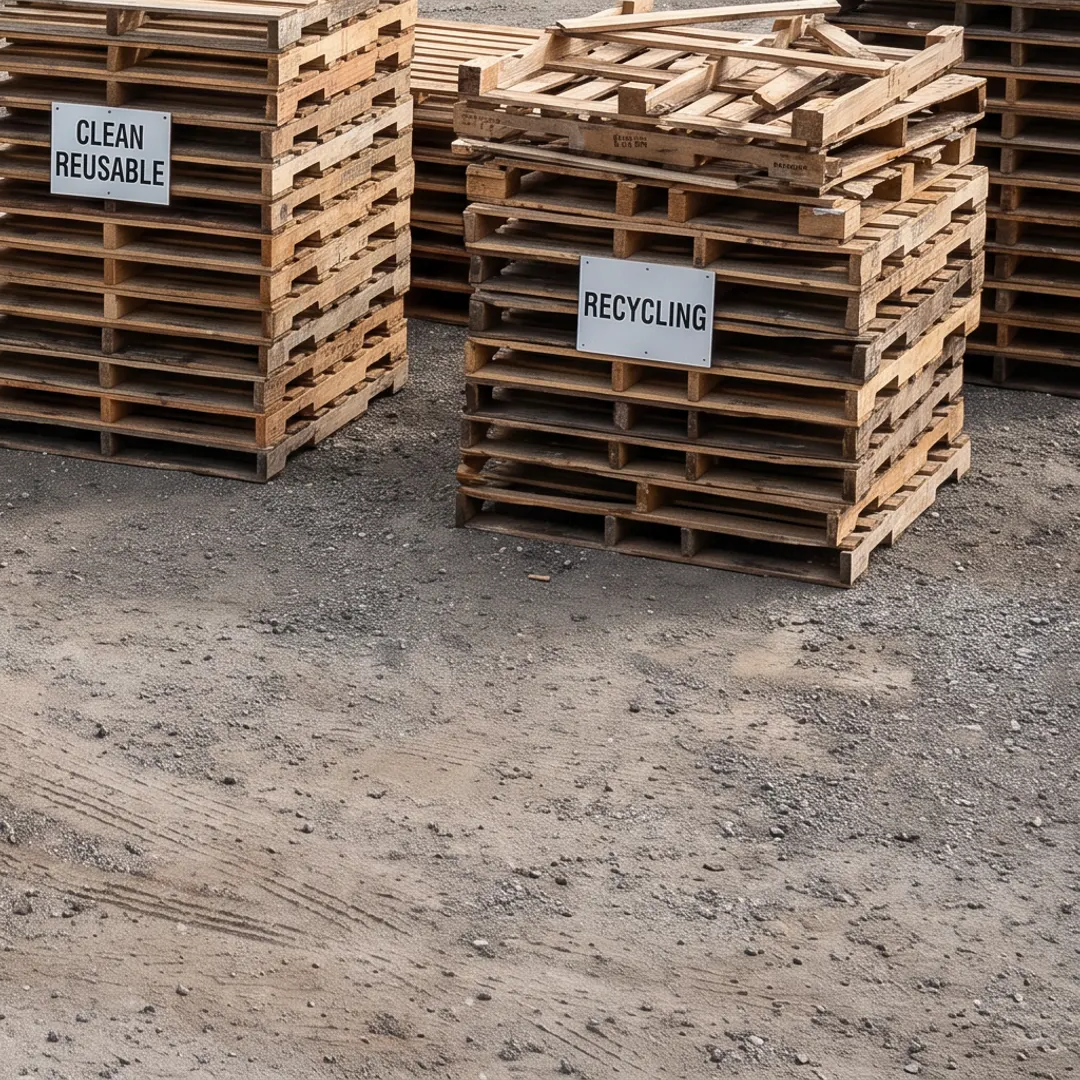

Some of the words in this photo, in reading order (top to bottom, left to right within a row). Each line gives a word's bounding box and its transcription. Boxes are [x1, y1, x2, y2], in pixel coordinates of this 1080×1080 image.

[76, 119, 144, 150] CLEAN
[55, 151, 165, 187] REUSABLE
[584, 291, 706, 331] RECYCLING
